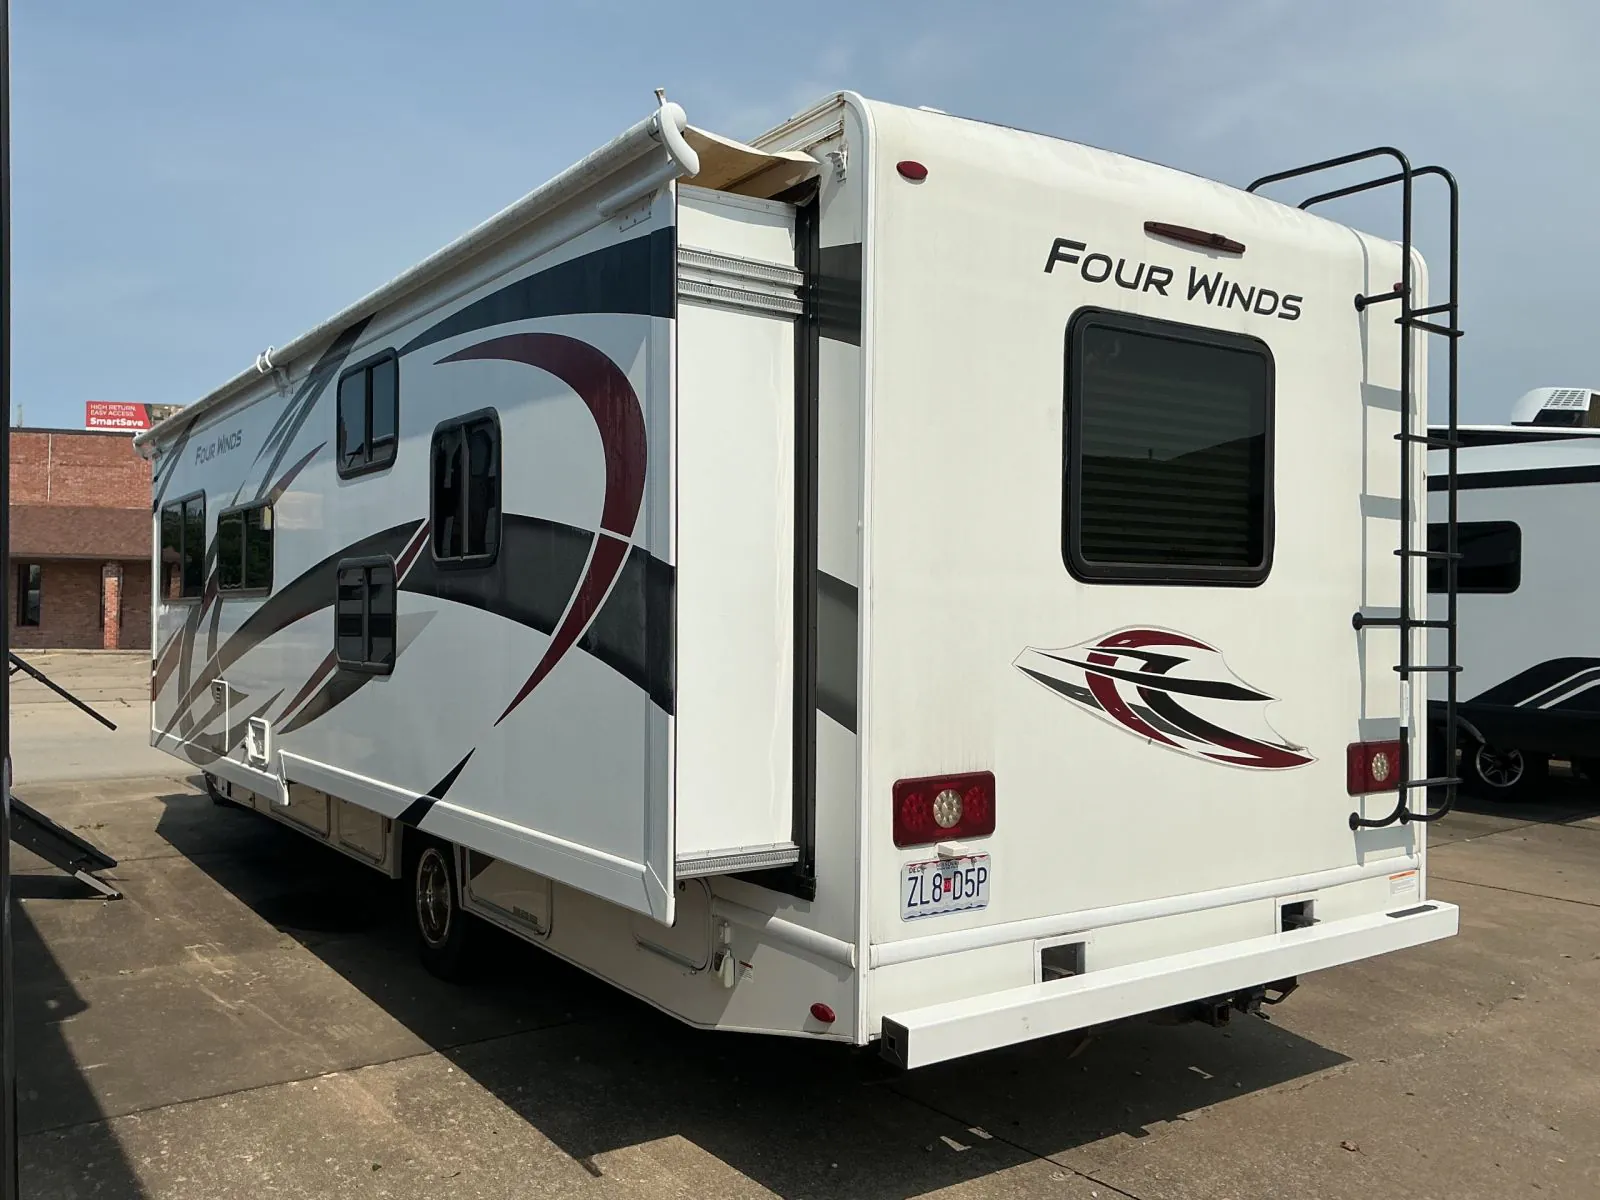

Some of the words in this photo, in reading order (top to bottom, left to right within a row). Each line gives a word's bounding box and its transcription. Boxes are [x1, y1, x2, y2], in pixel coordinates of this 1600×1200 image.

[1044, 237, 1174, 297] FOUR
[1187, 265, 1303, 321] WINDS
[90, 417, 144, 427] SmartSave
[195, 444, 216, 466] FOUR
[217, 429, 242, 456] WINDS
[907, 873, 943, 907] ZL8
[952, 867, 987, 900] D5P
